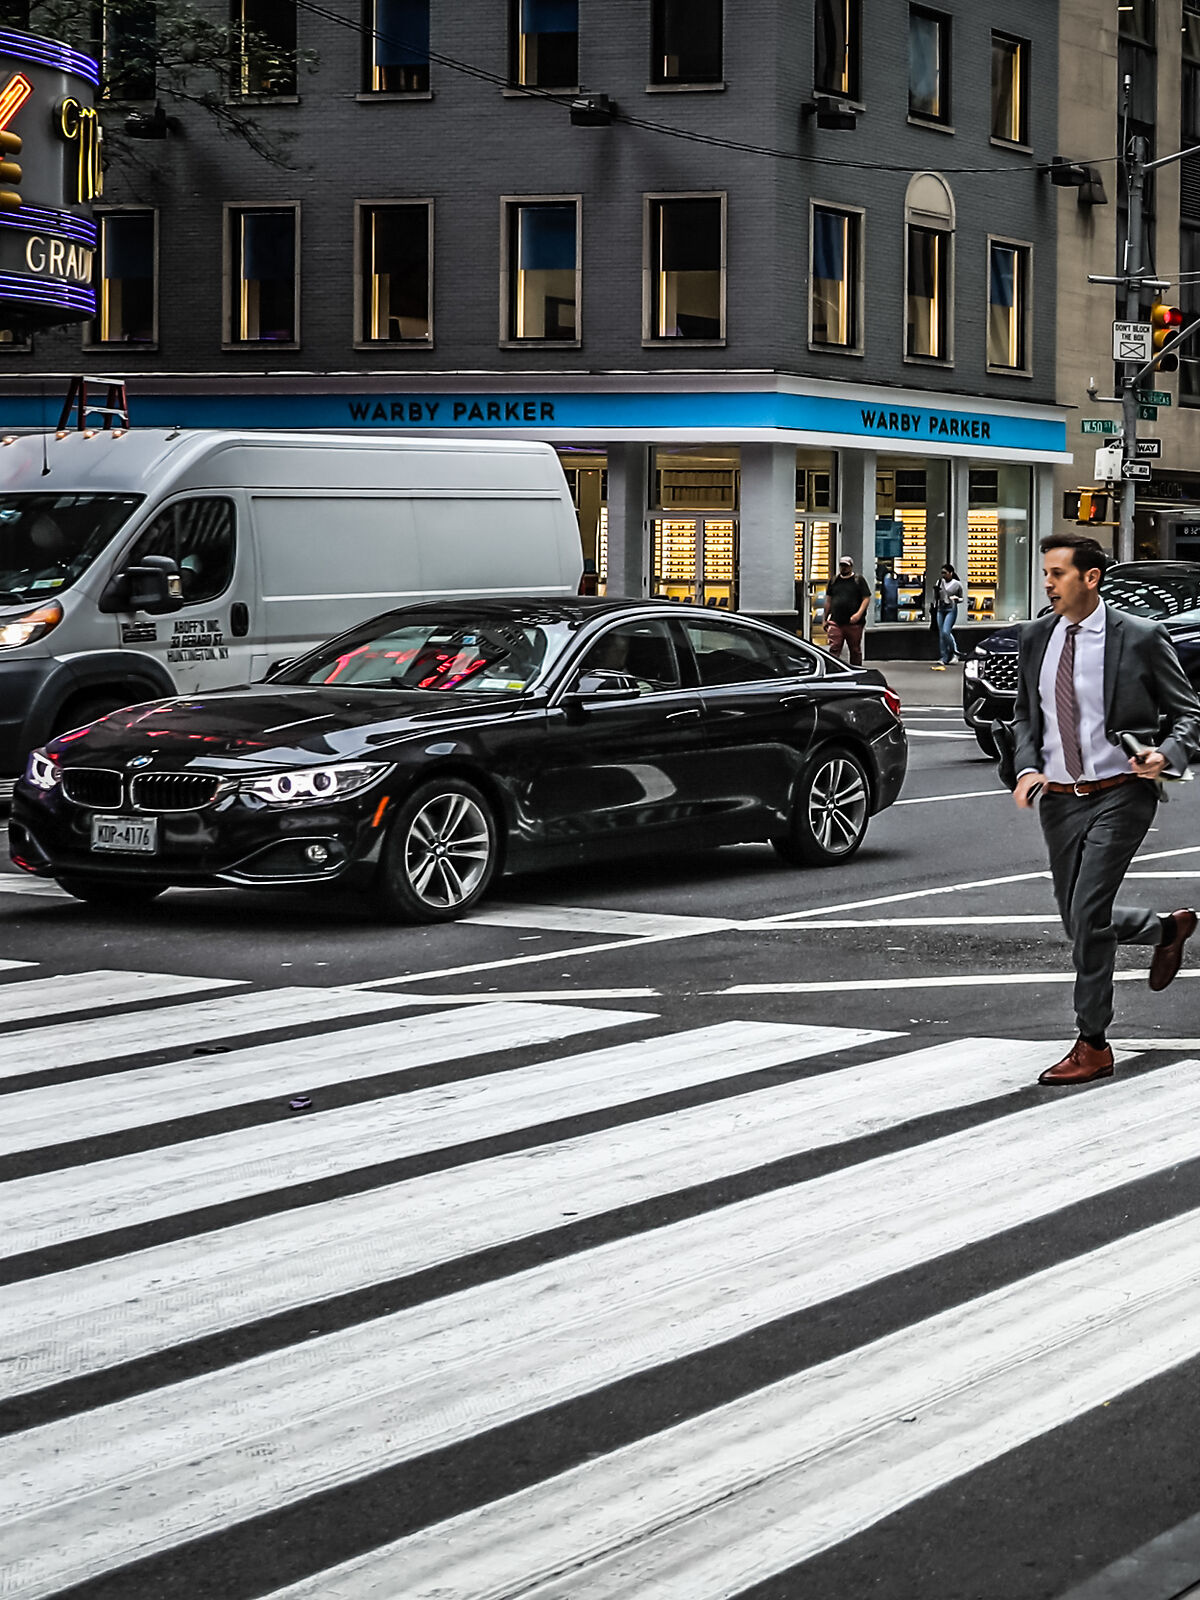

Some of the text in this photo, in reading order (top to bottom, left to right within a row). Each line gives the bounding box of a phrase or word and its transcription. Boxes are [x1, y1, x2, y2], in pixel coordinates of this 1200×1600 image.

[1116, 324, 1150, 333] DON'T BLOCK
[350, 402, 555, 421] WARBY PARKER
[861, 409, 990, 439] WARBY PARKER
[1137, 444, 1157, 453] WAY
